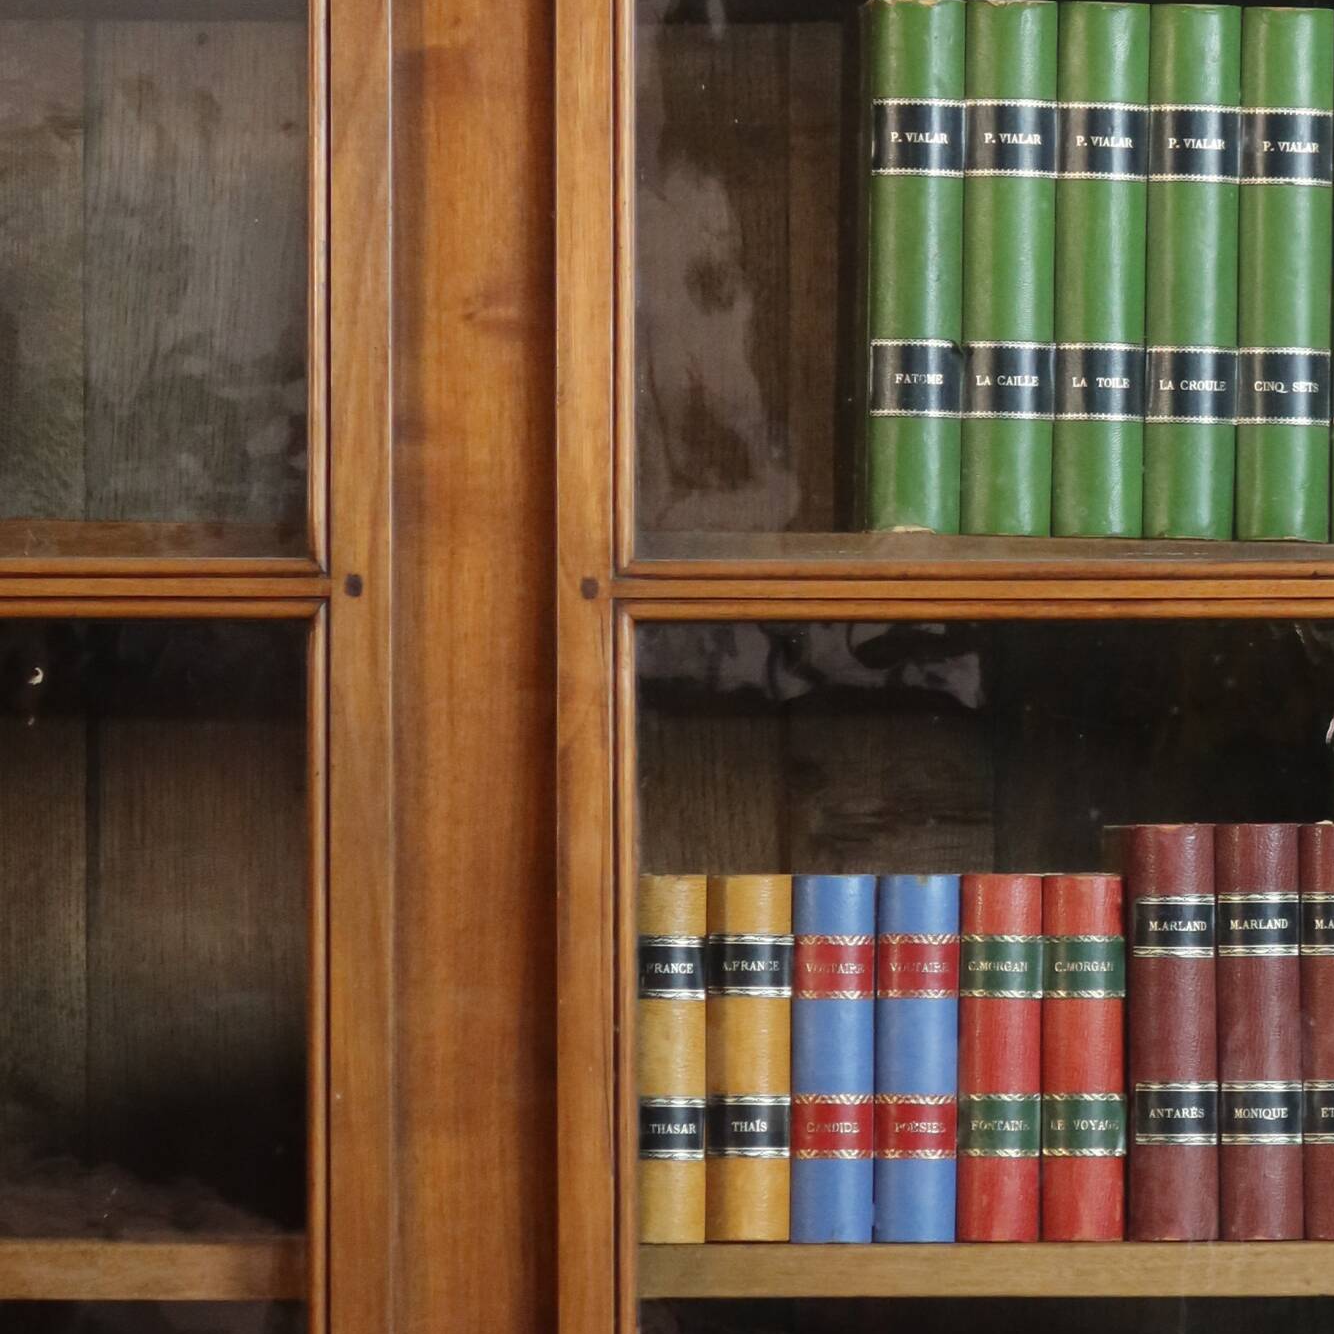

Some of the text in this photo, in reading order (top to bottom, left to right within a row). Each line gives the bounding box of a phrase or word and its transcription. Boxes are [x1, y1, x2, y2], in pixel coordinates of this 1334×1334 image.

[906, 132, 948, 145] VIALAR
[999, 133, 1042, 145] VIALAR
[1090, 135, 1133, 149] VIALAR
[1183, 138, 1225, 151] VIALAR
[1278, 140, 1320, 153] VIALAR
[895, 372, 944, 385] FATOME
[976, 374, 1039, 387] LA CAILLE
[1072, 377, 1130, 389] LA TOILE
[1159, 380, 1226, 392] LA CROULE
[1254, 380, 1319, 393] CINQ SETS
[1149, 920, 1207, 932] M.ARLAND
[1230, 918, 1288, 930] M.ARLAND
[1234, 1106, 1288, 1120] MONIQUE
